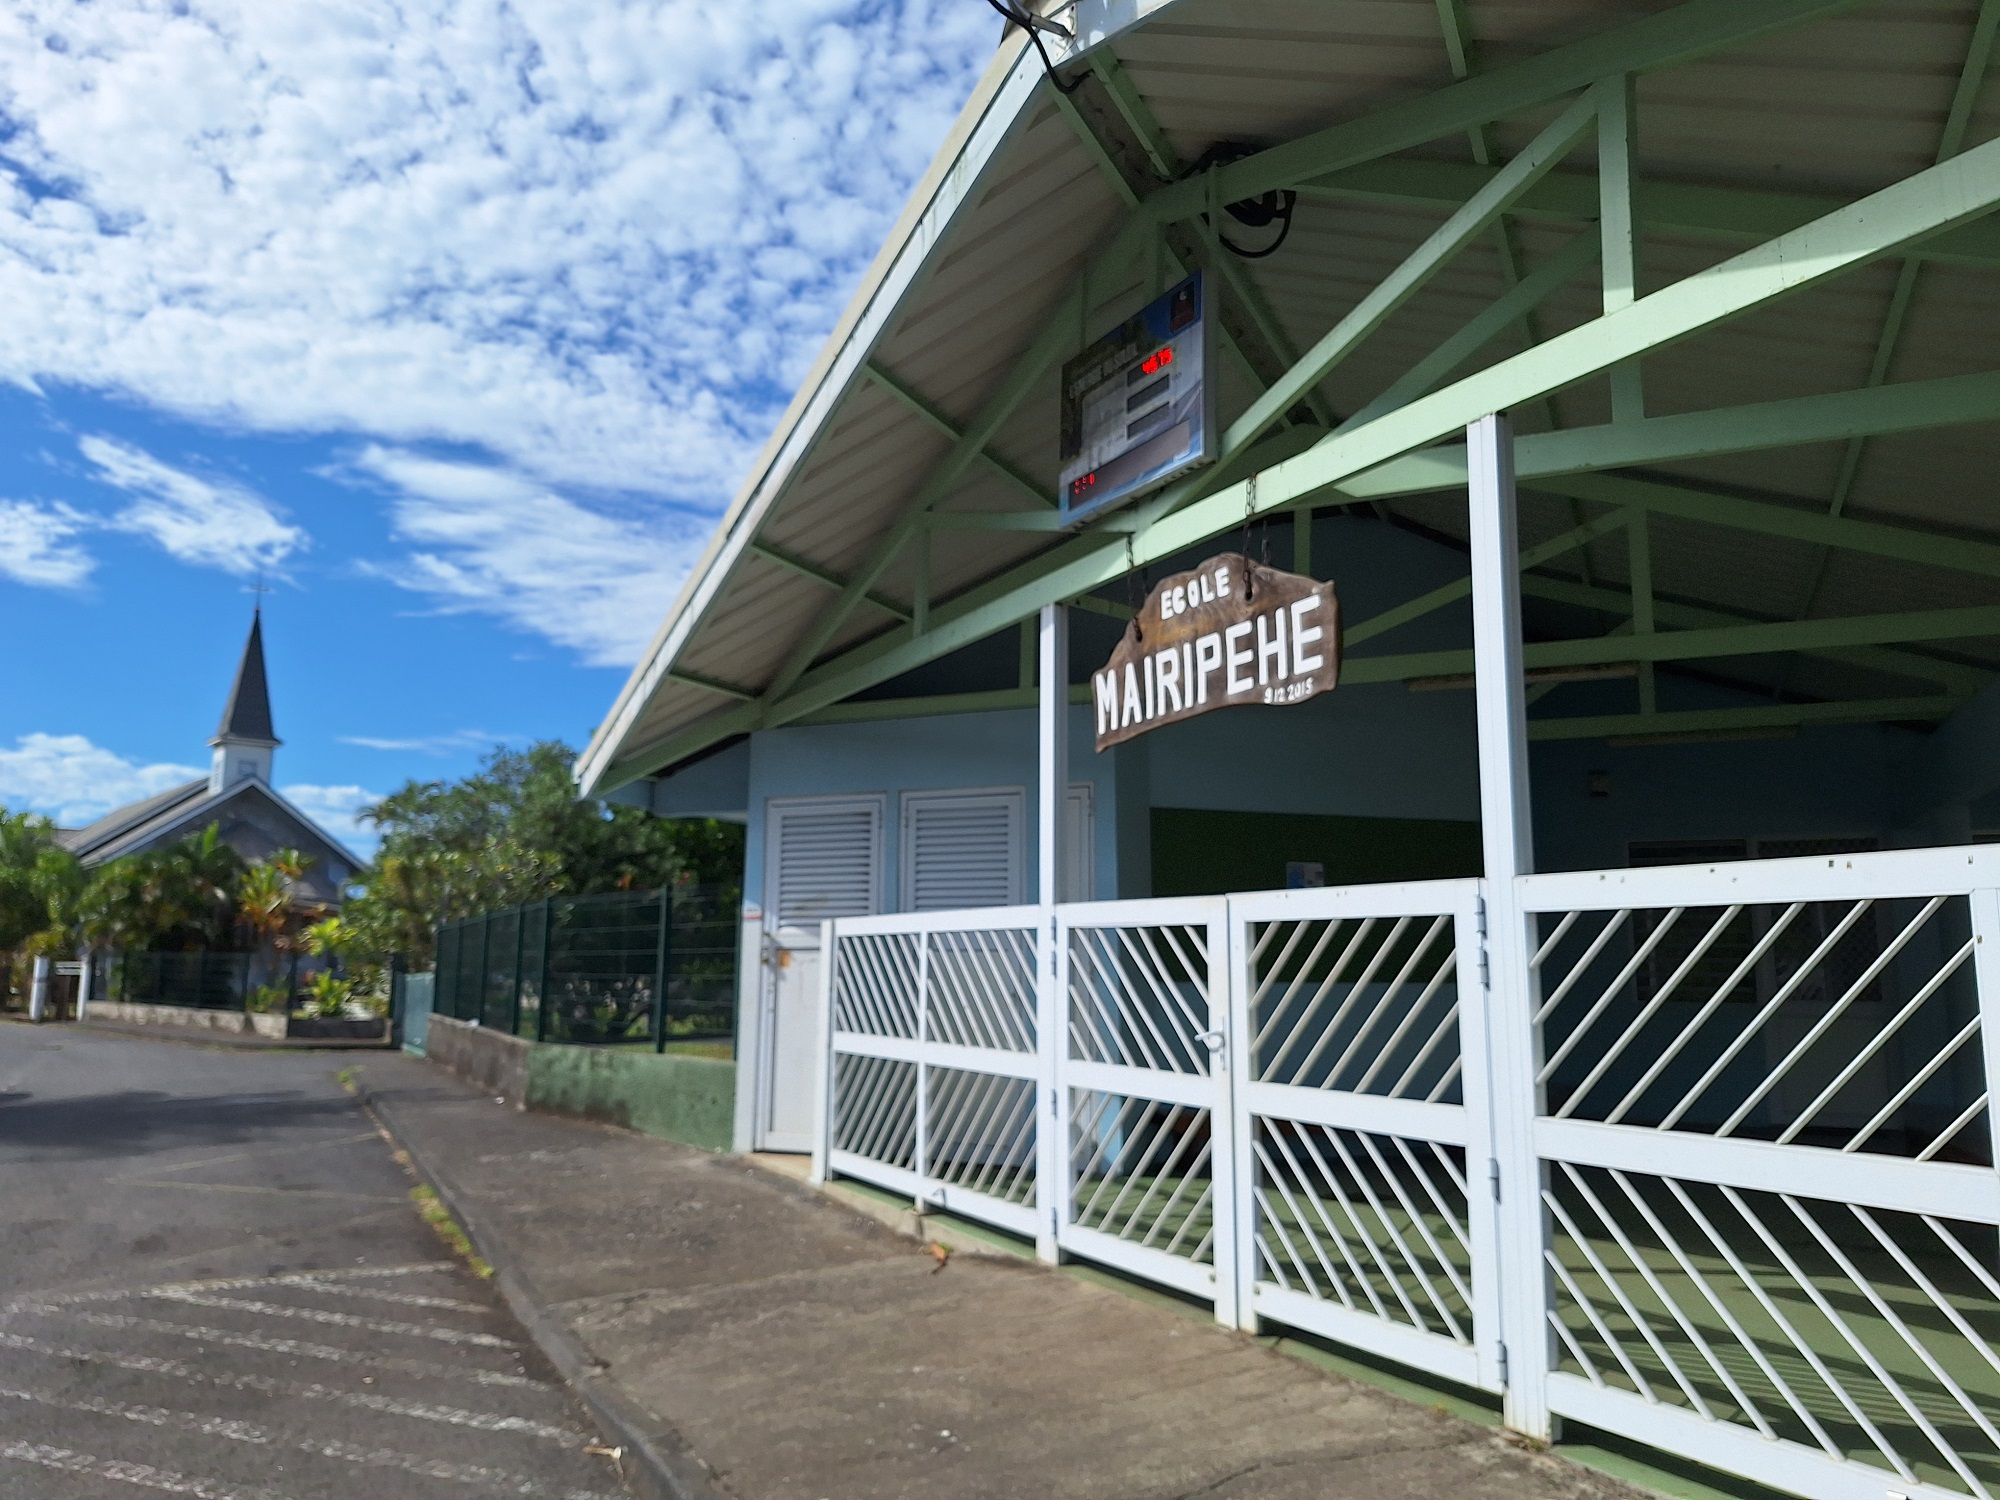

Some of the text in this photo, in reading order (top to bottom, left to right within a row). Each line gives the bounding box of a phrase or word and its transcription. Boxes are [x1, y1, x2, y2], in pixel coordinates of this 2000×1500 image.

[1161, 566, 1231, 620] ECOLE
[1095, 594, 1324, 735] MAIRIPEHE
[1286, 677, 1314, 701] 2015
